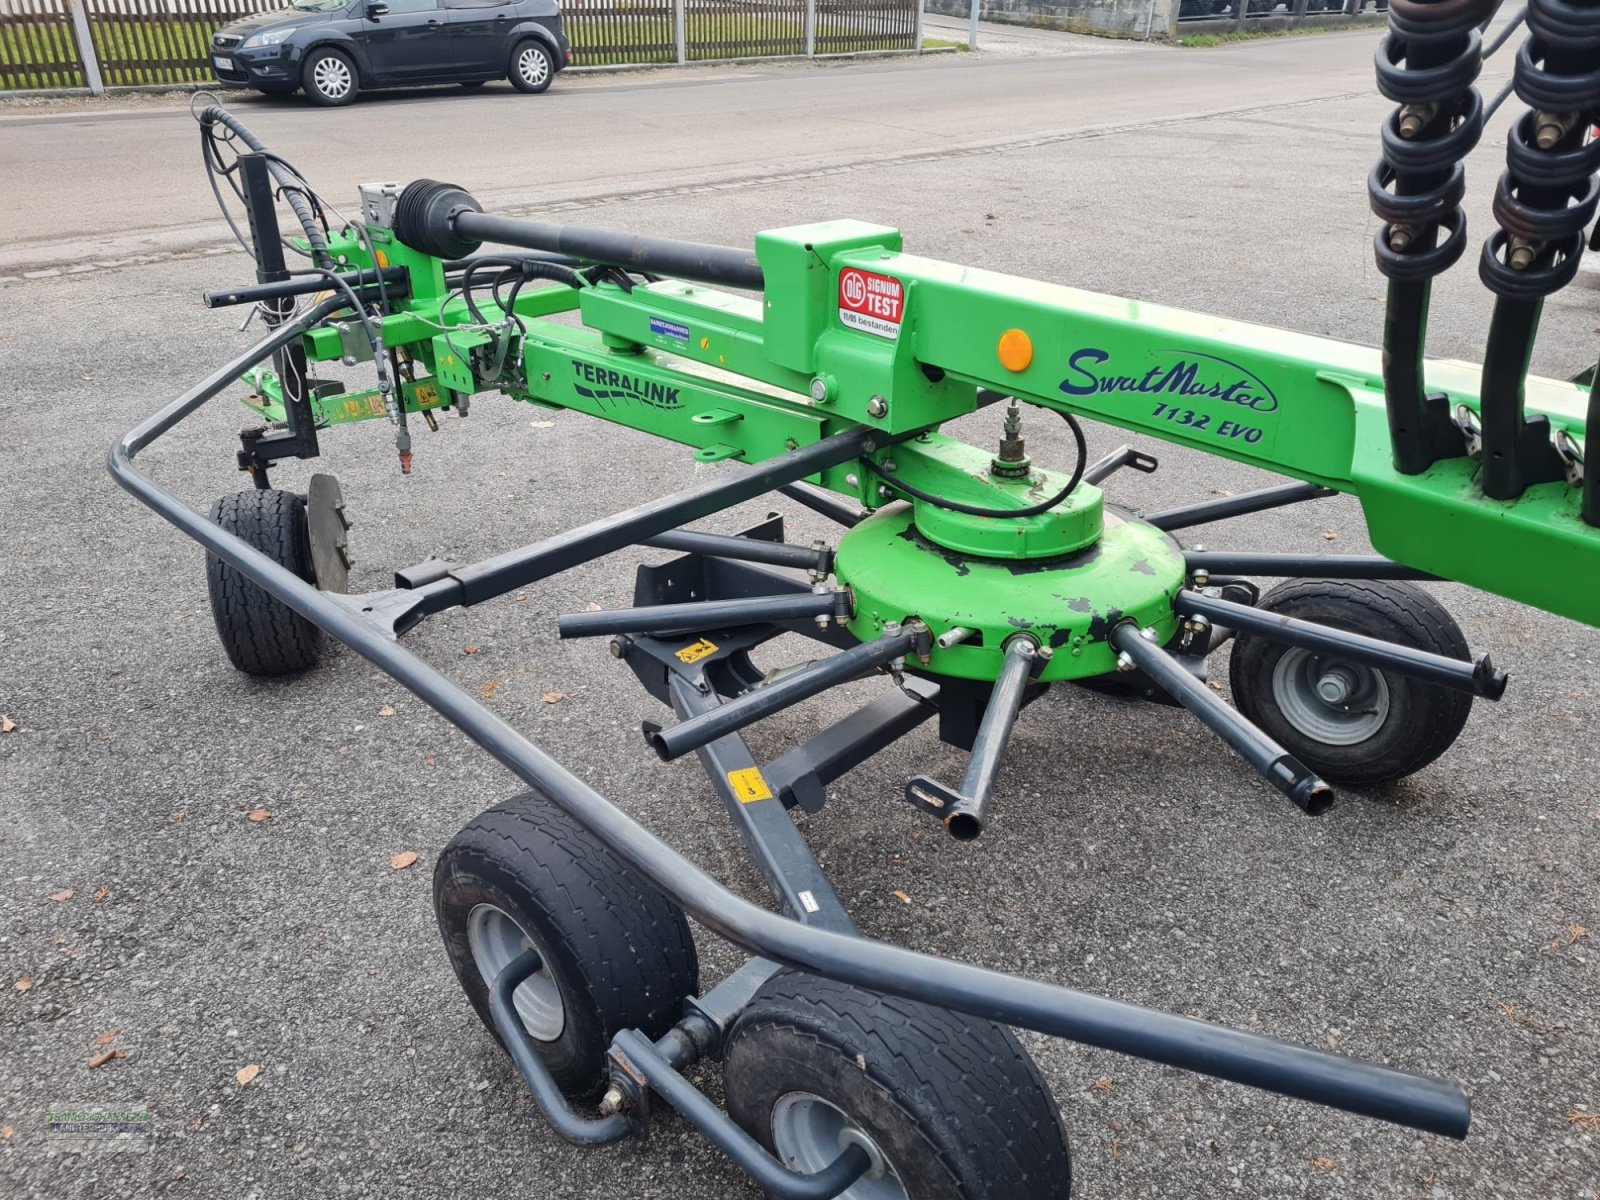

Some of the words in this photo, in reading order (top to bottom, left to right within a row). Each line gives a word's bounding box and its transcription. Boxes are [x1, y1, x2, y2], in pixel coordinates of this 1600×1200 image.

[846, 274, 863, 301] DLG
[867, 278, 900, 298] SIGNUM
[867, 293, 899, 318] TEST
[858, 316, 898, 334] bestanden
[571, 360, 681, 404] TERRALINK
[1058, 348, 1275, 410] SwatMaster
[1152, 402, 1211, 431] 7132
[1216, 420, 1264, 444] EVO
